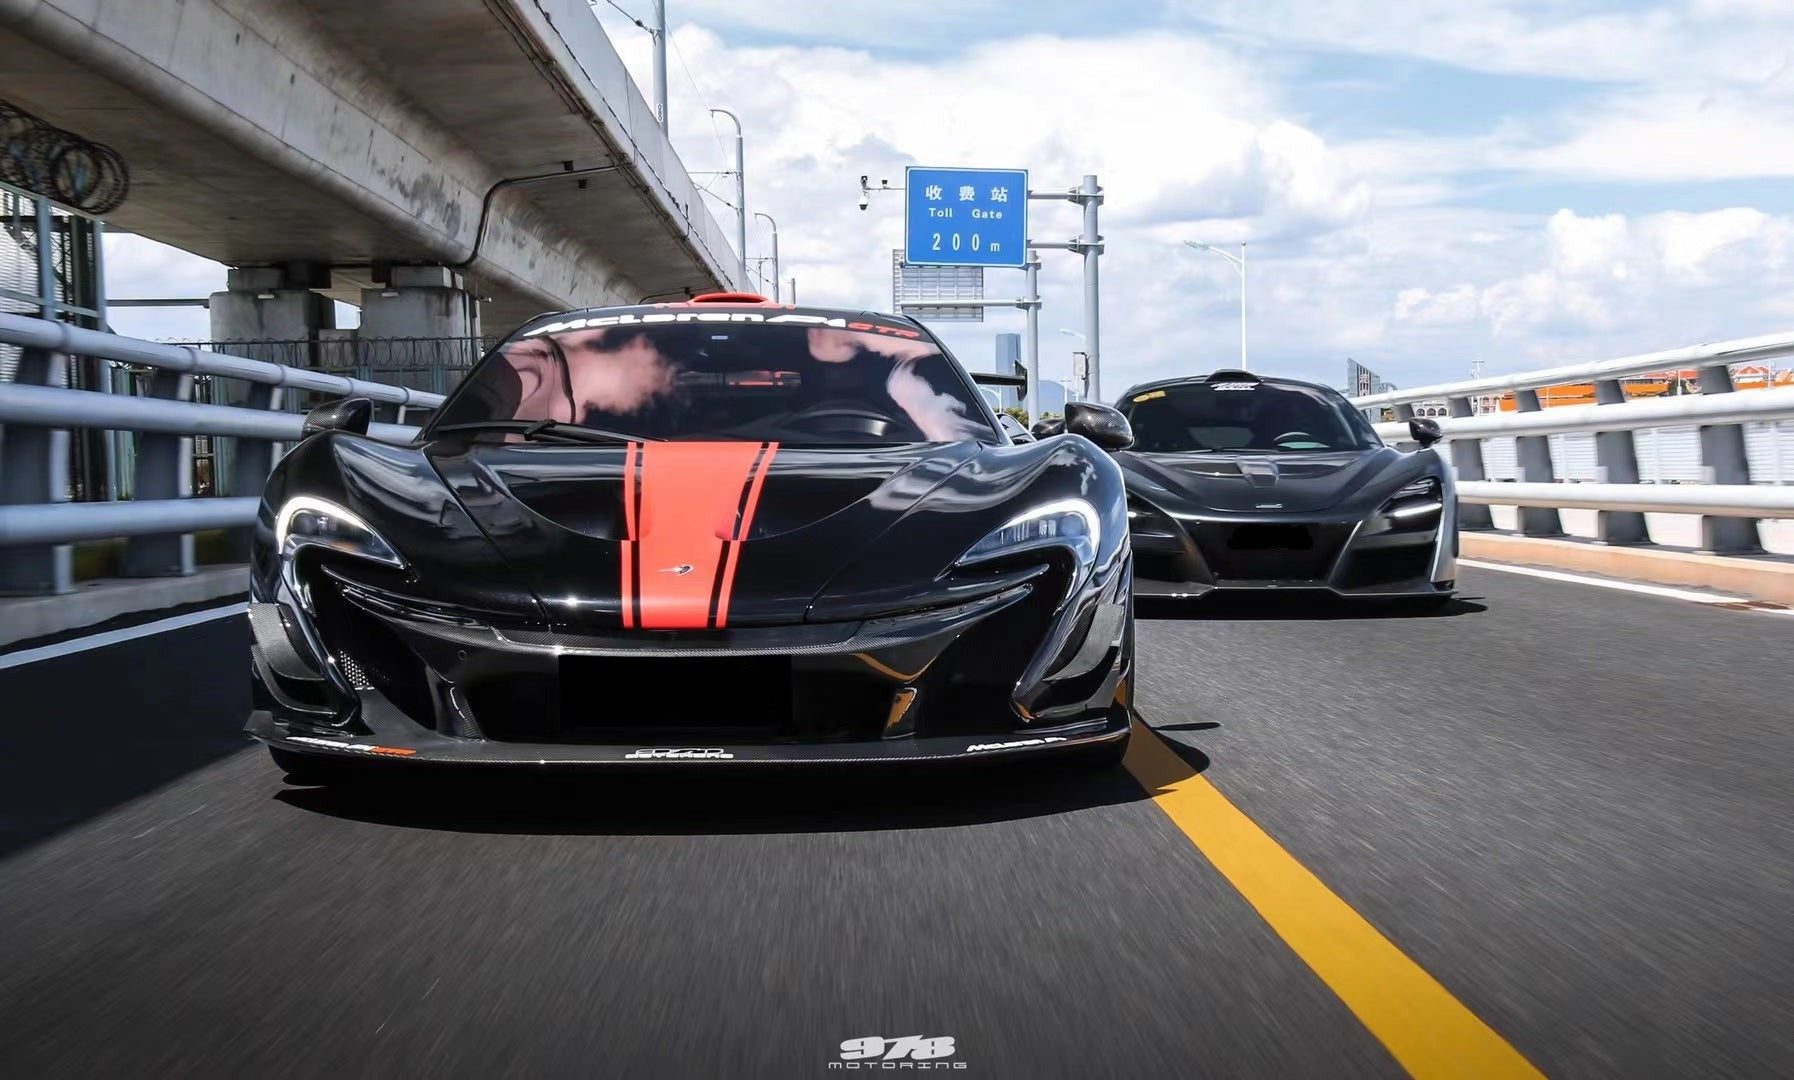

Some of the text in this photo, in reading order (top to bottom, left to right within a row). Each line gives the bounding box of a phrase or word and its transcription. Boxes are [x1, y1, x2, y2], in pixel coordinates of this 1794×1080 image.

[925, 185, 1008, 202] 收费站
[928, 207, 1003, 219] Toll Gate
[848, 322, 920, 338] GTR
